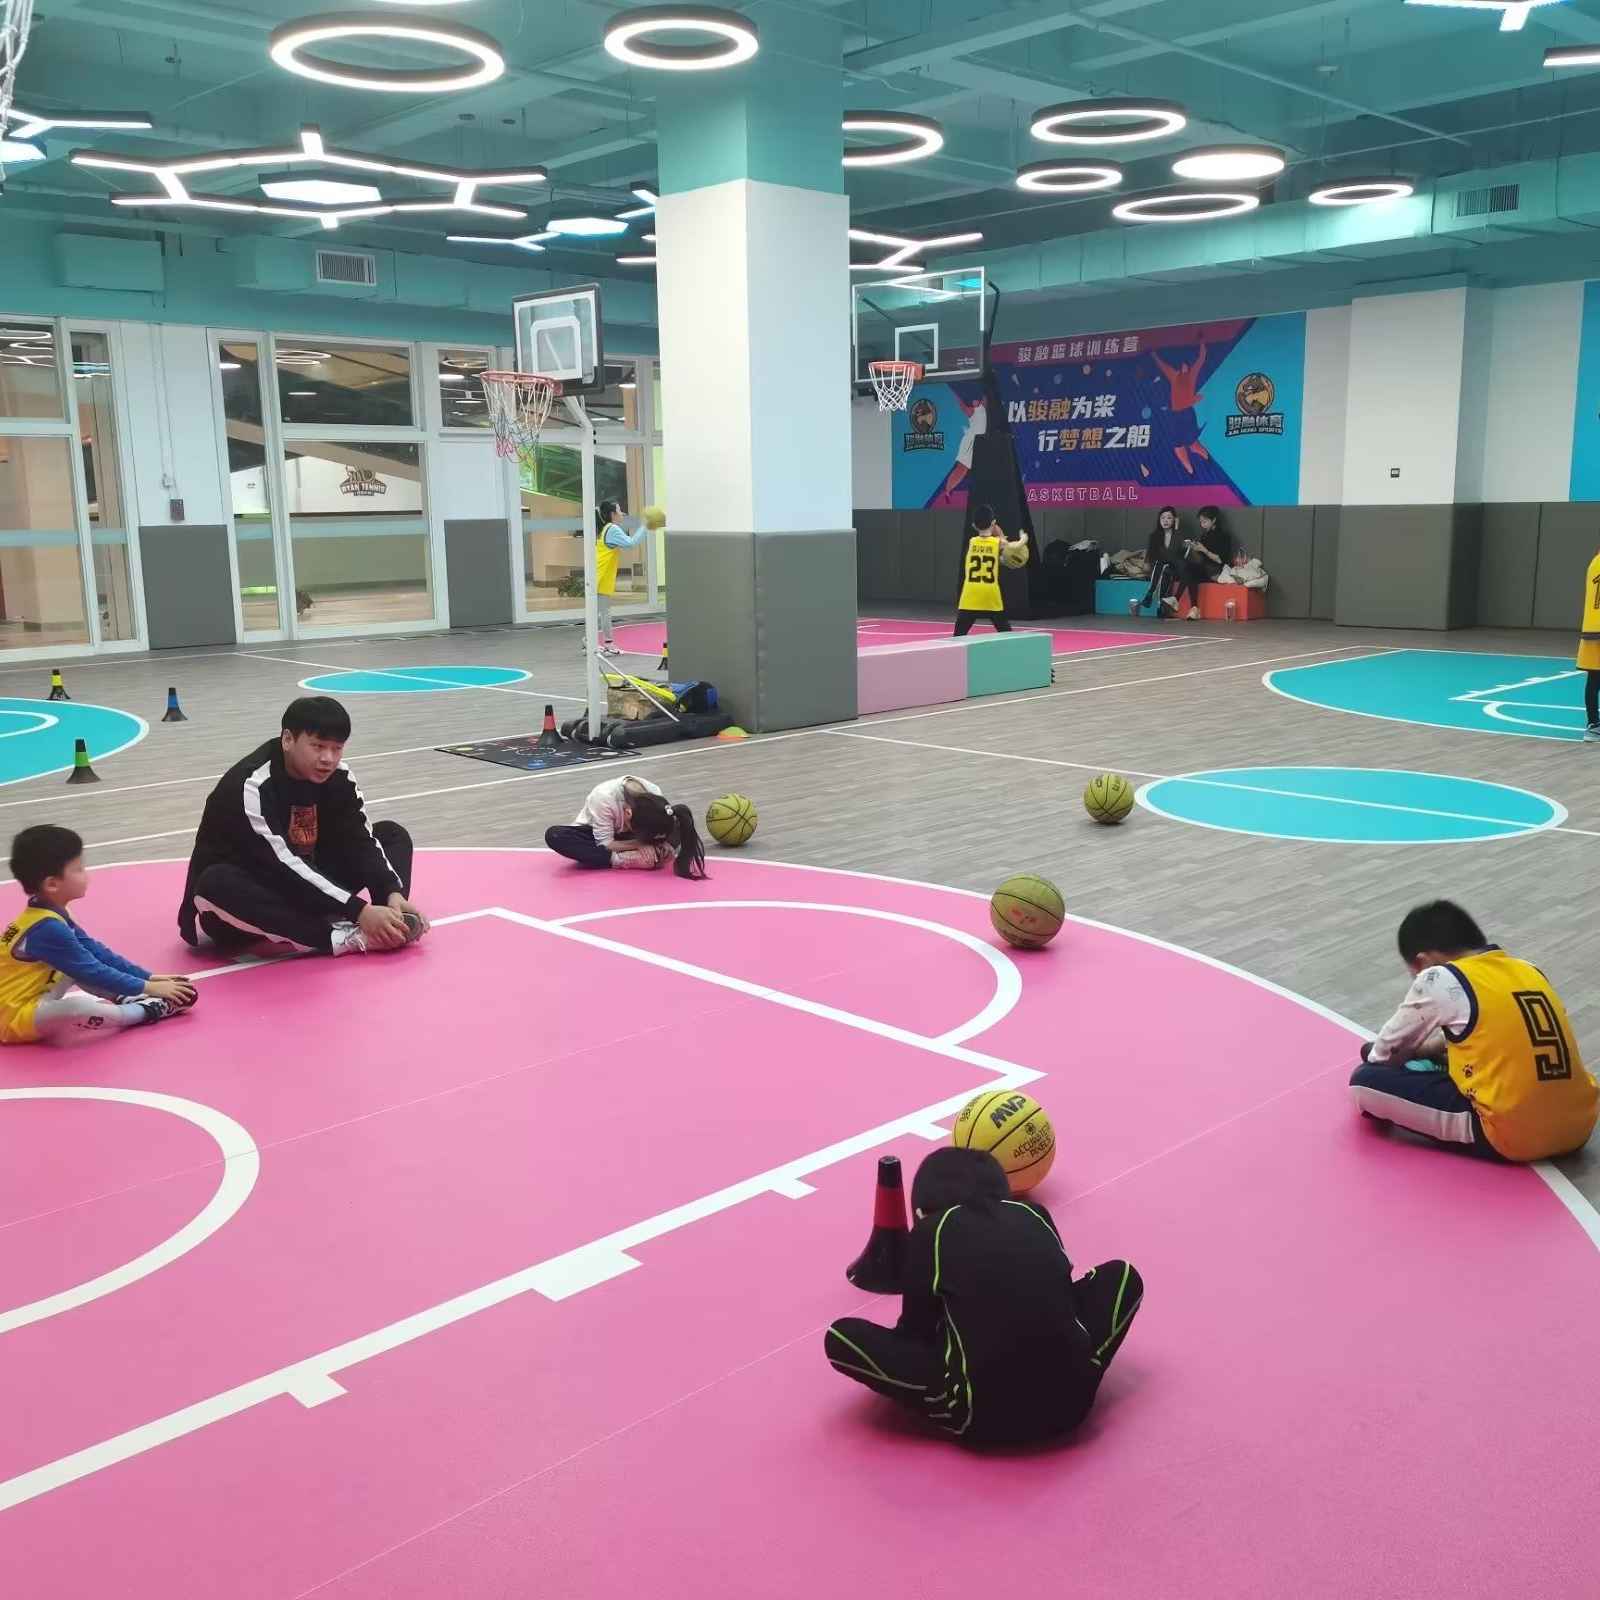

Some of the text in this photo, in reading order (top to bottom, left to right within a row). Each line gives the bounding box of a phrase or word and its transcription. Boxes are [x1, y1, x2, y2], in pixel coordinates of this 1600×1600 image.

[1017, 336, 1139, 363] 骏融篮球训练营
[1007, 394, 1117, 423] 以骏融为桨
[1037, 424, 1151, 452] 行梦想之船
[1026, 486, 1138, 502] ASKETBALL
[968, 555, 996, 584] 23
[1512, 990, 1572, 1081] 9
[990, 1095, 1027, 1129] MVP
